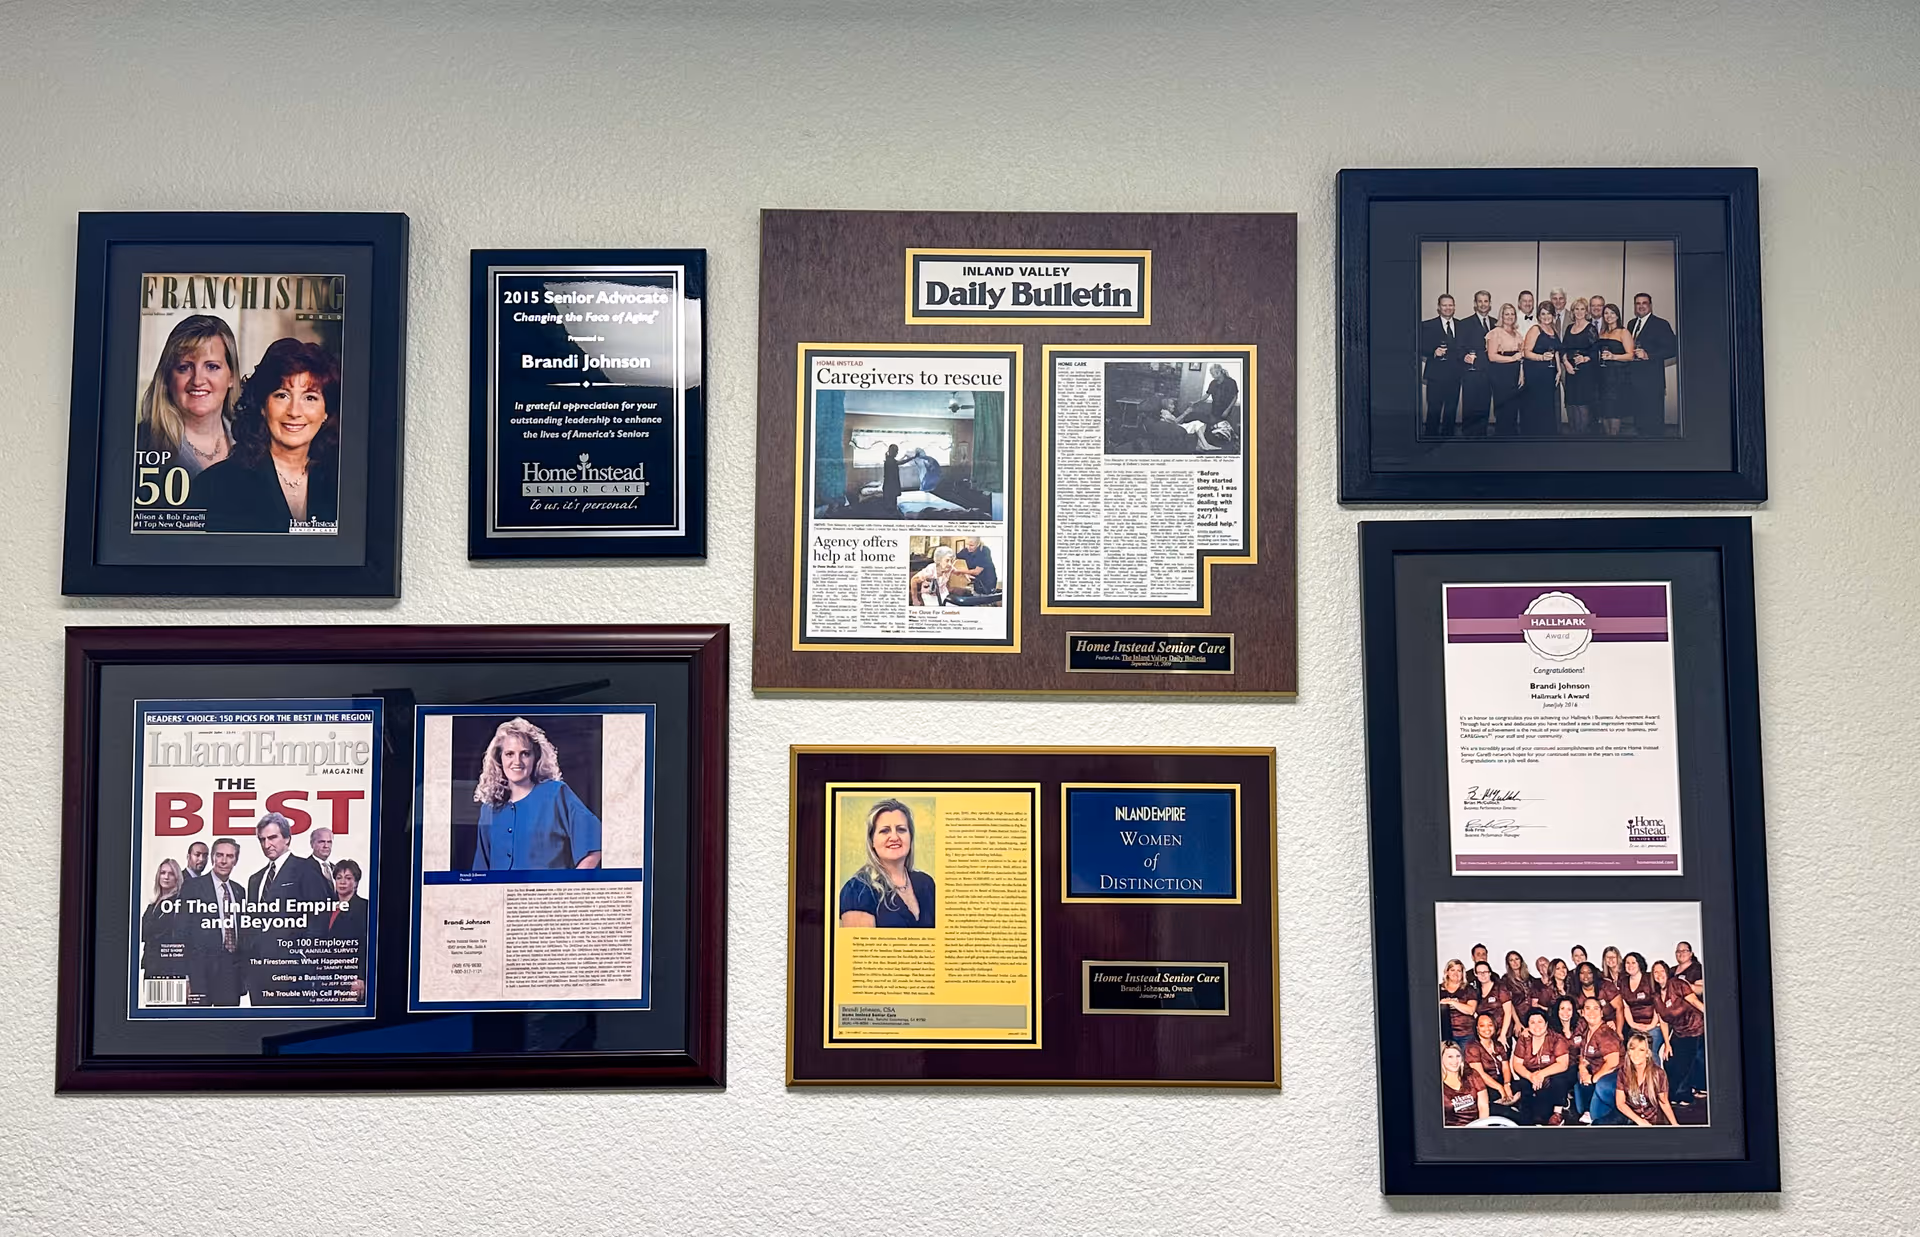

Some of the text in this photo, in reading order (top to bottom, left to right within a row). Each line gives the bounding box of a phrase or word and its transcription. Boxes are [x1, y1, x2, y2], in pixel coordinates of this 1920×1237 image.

[962, 266, 1070, 277] INLAND VALLEY
[142, 275, 345, 310] FRANCHISING
[504, 291, 669, 304] 2015 Senior Advocate
[925, 280, 1132, 310] Daily Bulletin
[513, 312, 564, 325] Changing
[565, 312, 583, 323] the
[586, 312, 609, 323] Face
[612, 312, 627, 325] of
[522, 354, 650, 371] Brandi Johnson
[817, 368, 1003, 388] Caregivers to rescue
[514, 401, 657, 413] In grateful appreciation for your
[510, 415, 662, 426] outstanding leadership to enhance
[523, 430, 649, 440] the lives of America's Seniors
[136, 451, 171, 465] TOP
[522, 461, 645, 481] Home Instead
[134, 467, 190, 506] 50
[525, 485, 641, 494] SENIOR CARE
[530, 499, 542, 510] To
[562, 498, 580, 510] it's
[581, 497, 640, 513] personal.
[134, 513, 206, 521] Alison & Bob Fanelli
[290, 518, 312, 527] Home
[143, 521, 158, 530] Top
[158, 521, 175, 529] New
[176, 521, 206, 530] Qualifier
[813, 536, 898, 549] Agency offers
[813, 549, 896, 564] help at home
[1531, 617, 1586, 627] HALLMARK
[1545, 632, 1570, 640] Award
[1076, 640, 1226, 654] Home Instead Senior Care
[1533, 666, 1585, 675] Congratulations!
[1530, 682, 1590, 691] Brandi Johnson
[219, 714, 233, 722] 150
[235, 714, 258, 722] PICKS
[260, 714, 275, 722] FOR
[277, 713, 291, 722] THE
[293, 713, 311, 722] BEST
[314, 713, 322, 721] IN
[325, 713, 339, 721] THE
[341, 713, 371, 721] REGION
[215, 778, 255, 790] THE
[155, 790, 365, 836] BEST
[1635, 816, 1663, 827] Home
[1629, 824, 1666, 836] Instead
[1120, 831, 1182, 846] WOMEN
[1144, 853, 1160, 871] of
[1100, 875, 1203, 890] DISTINCTION
[160, 899, 350, 917] Of The Inland Empire
[200, 914, 307, 932] and Beyond
[277, 938, 358, 948] Top 100 Employers
[321, 958, 358, 966] Happened?
[272, 974, 297, 982] Getting
[334, 974, 358, 982] Degree
[1094, 973, 1220, 983] Home Instead Senior Care
